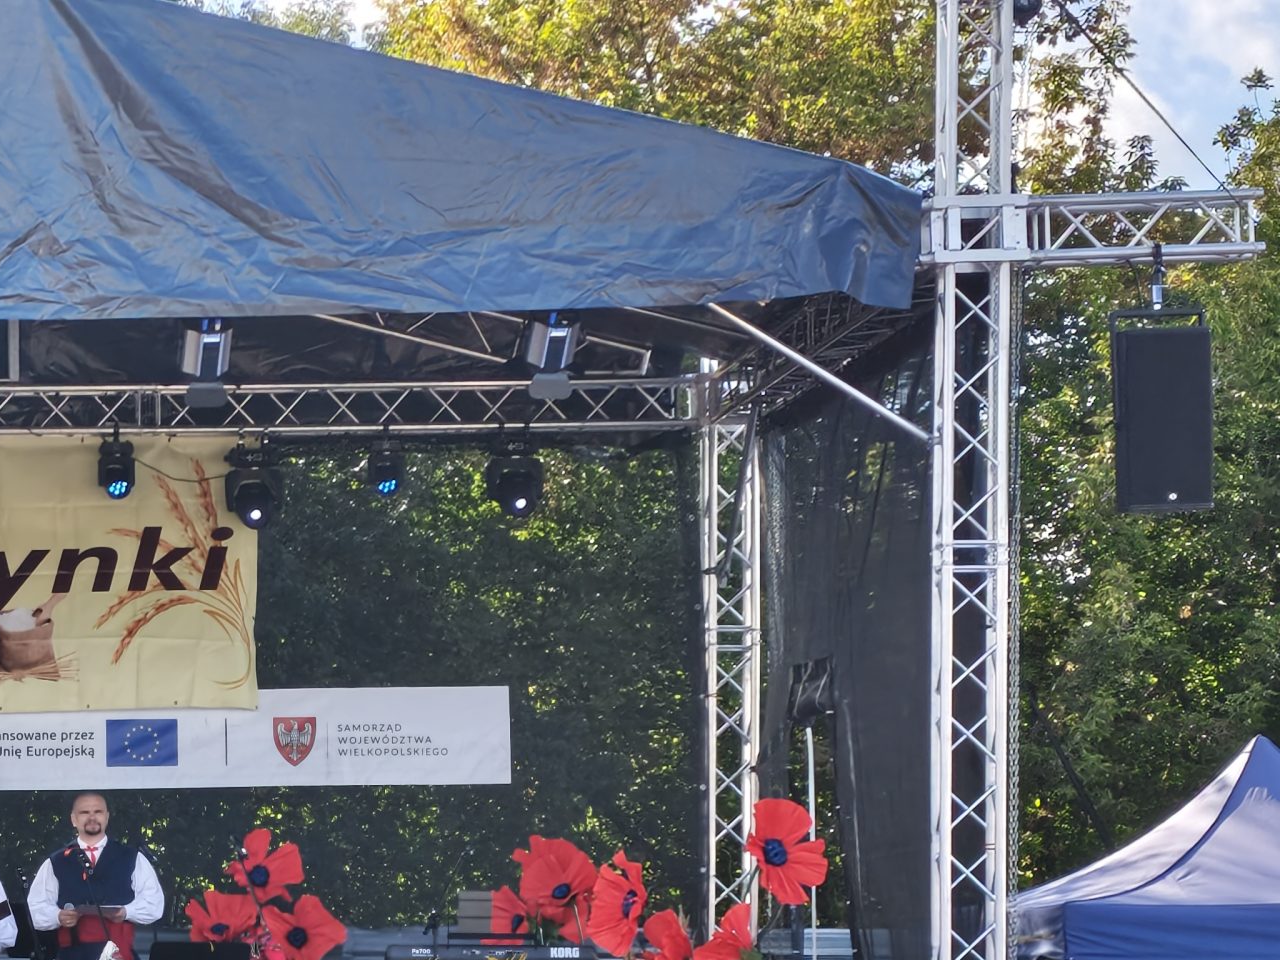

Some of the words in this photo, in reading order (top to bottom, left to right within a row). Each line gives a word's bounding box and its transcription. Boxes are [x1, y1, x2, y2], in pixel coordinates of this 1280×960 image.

[337, 723, 402, 733] SAMORZĄD
[60, 731, 95, 746] przez
[337, 734, 432, 745] WOJEWÓDZTWA
[26, 744, 95, 761] Europejską
[337, 747, 449, 757] WIELKOPOLSKIEGO
[549, 947, 580, 958] KORG
